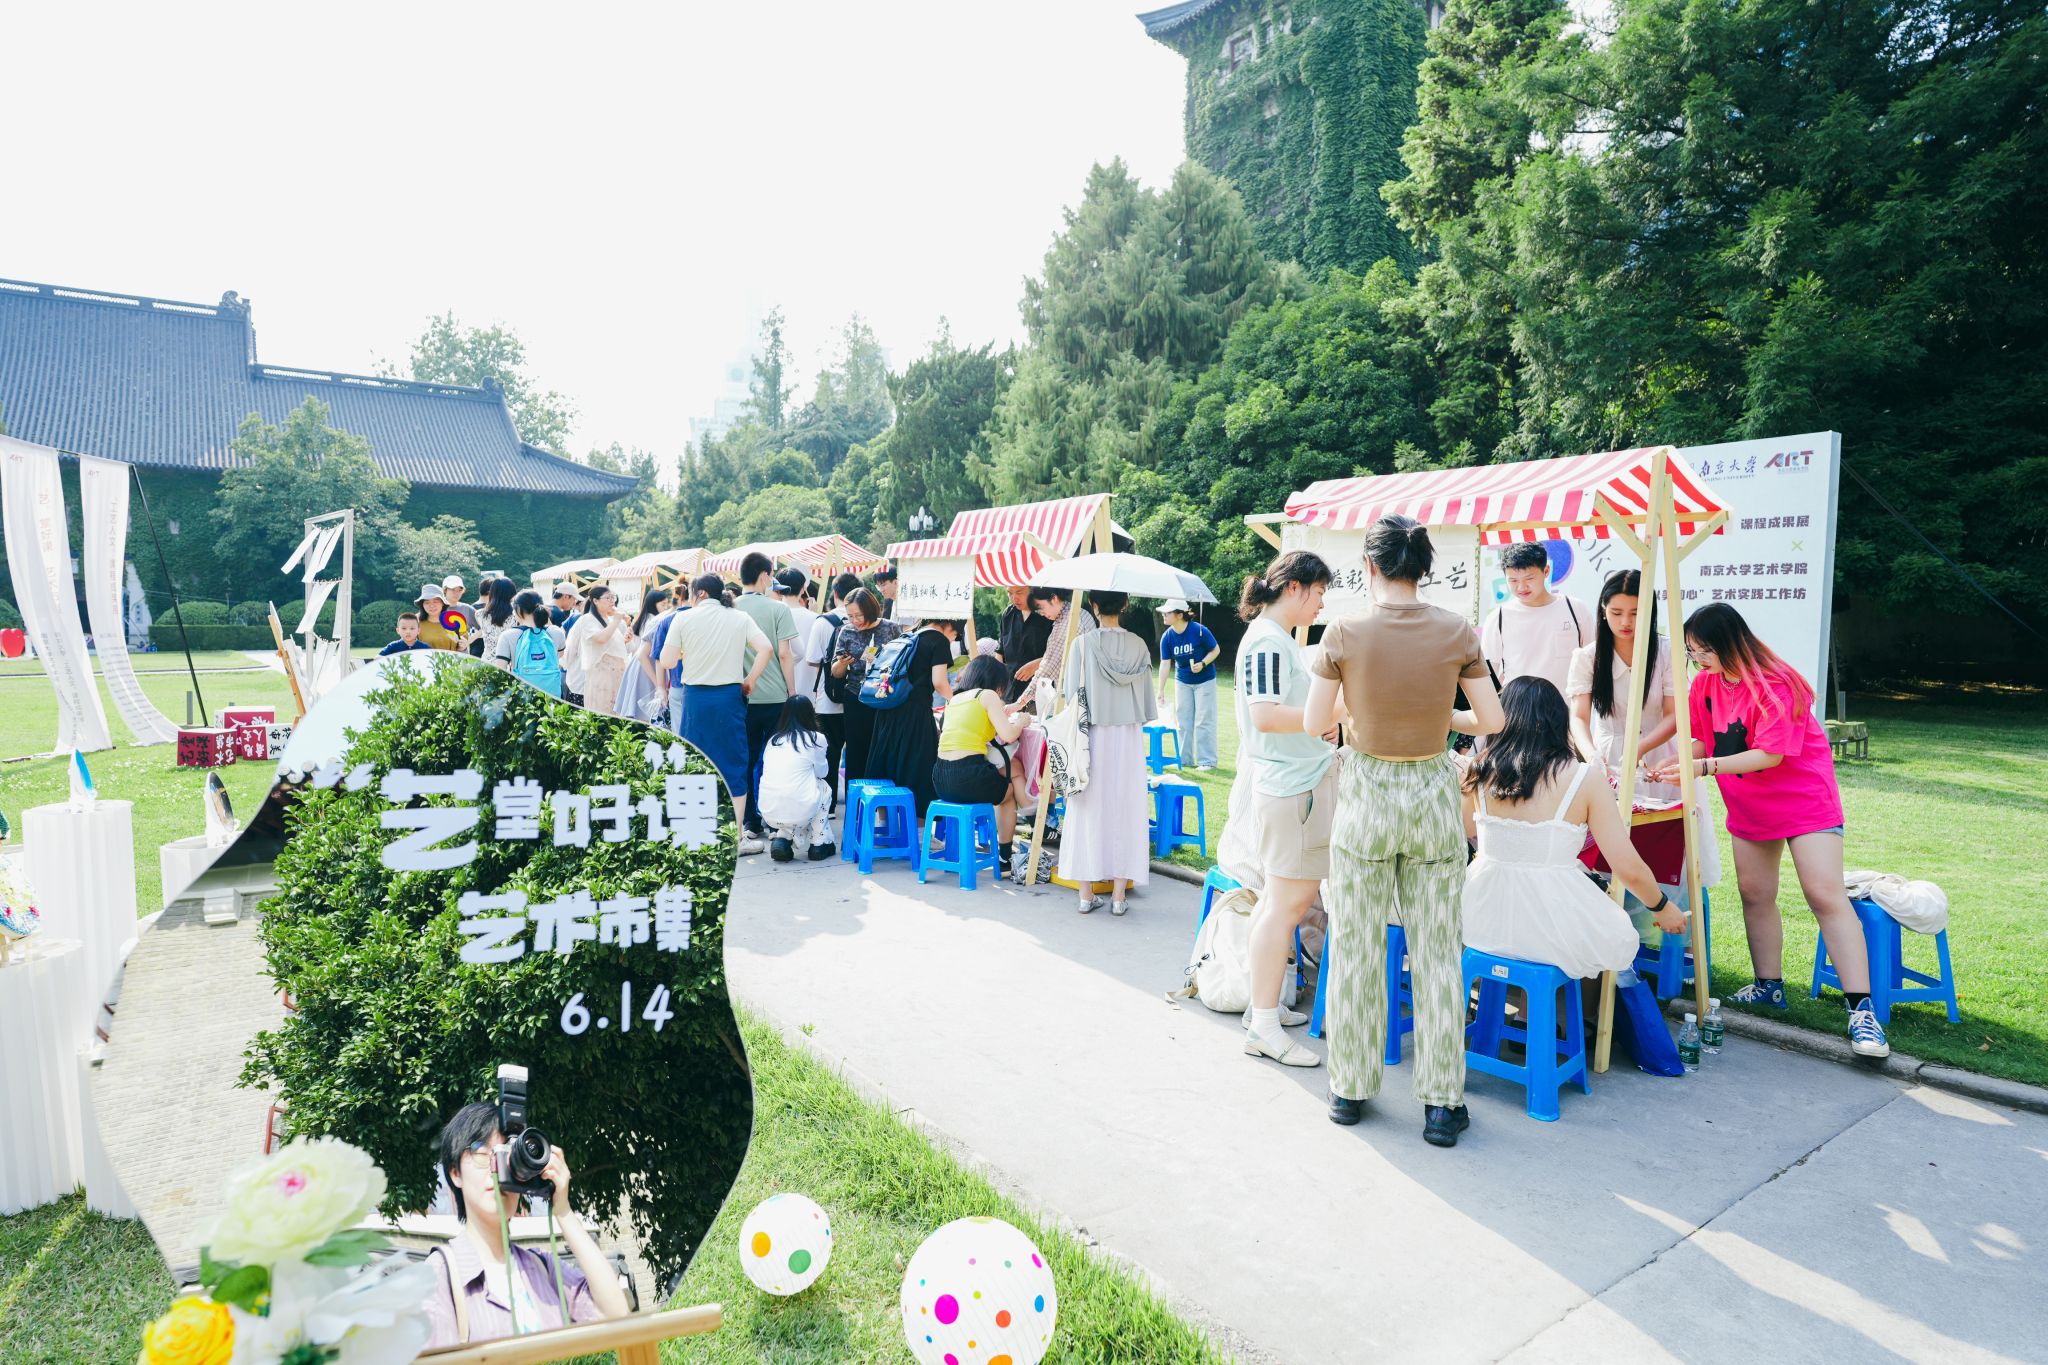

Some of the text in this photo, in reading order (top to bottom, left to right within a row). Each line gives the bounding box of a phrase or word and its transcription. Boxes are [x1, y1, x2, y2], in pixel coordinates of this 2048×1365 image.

[1763, 450, 1814, 468] ART
[1740, 515, 1809, 530] 课程成果展
[1700, 563, 1808, 577] 南京大学艺术学院
[457, 885, 693, 963] 艺术市集
[560, 981, 674, 1035] 6.14
